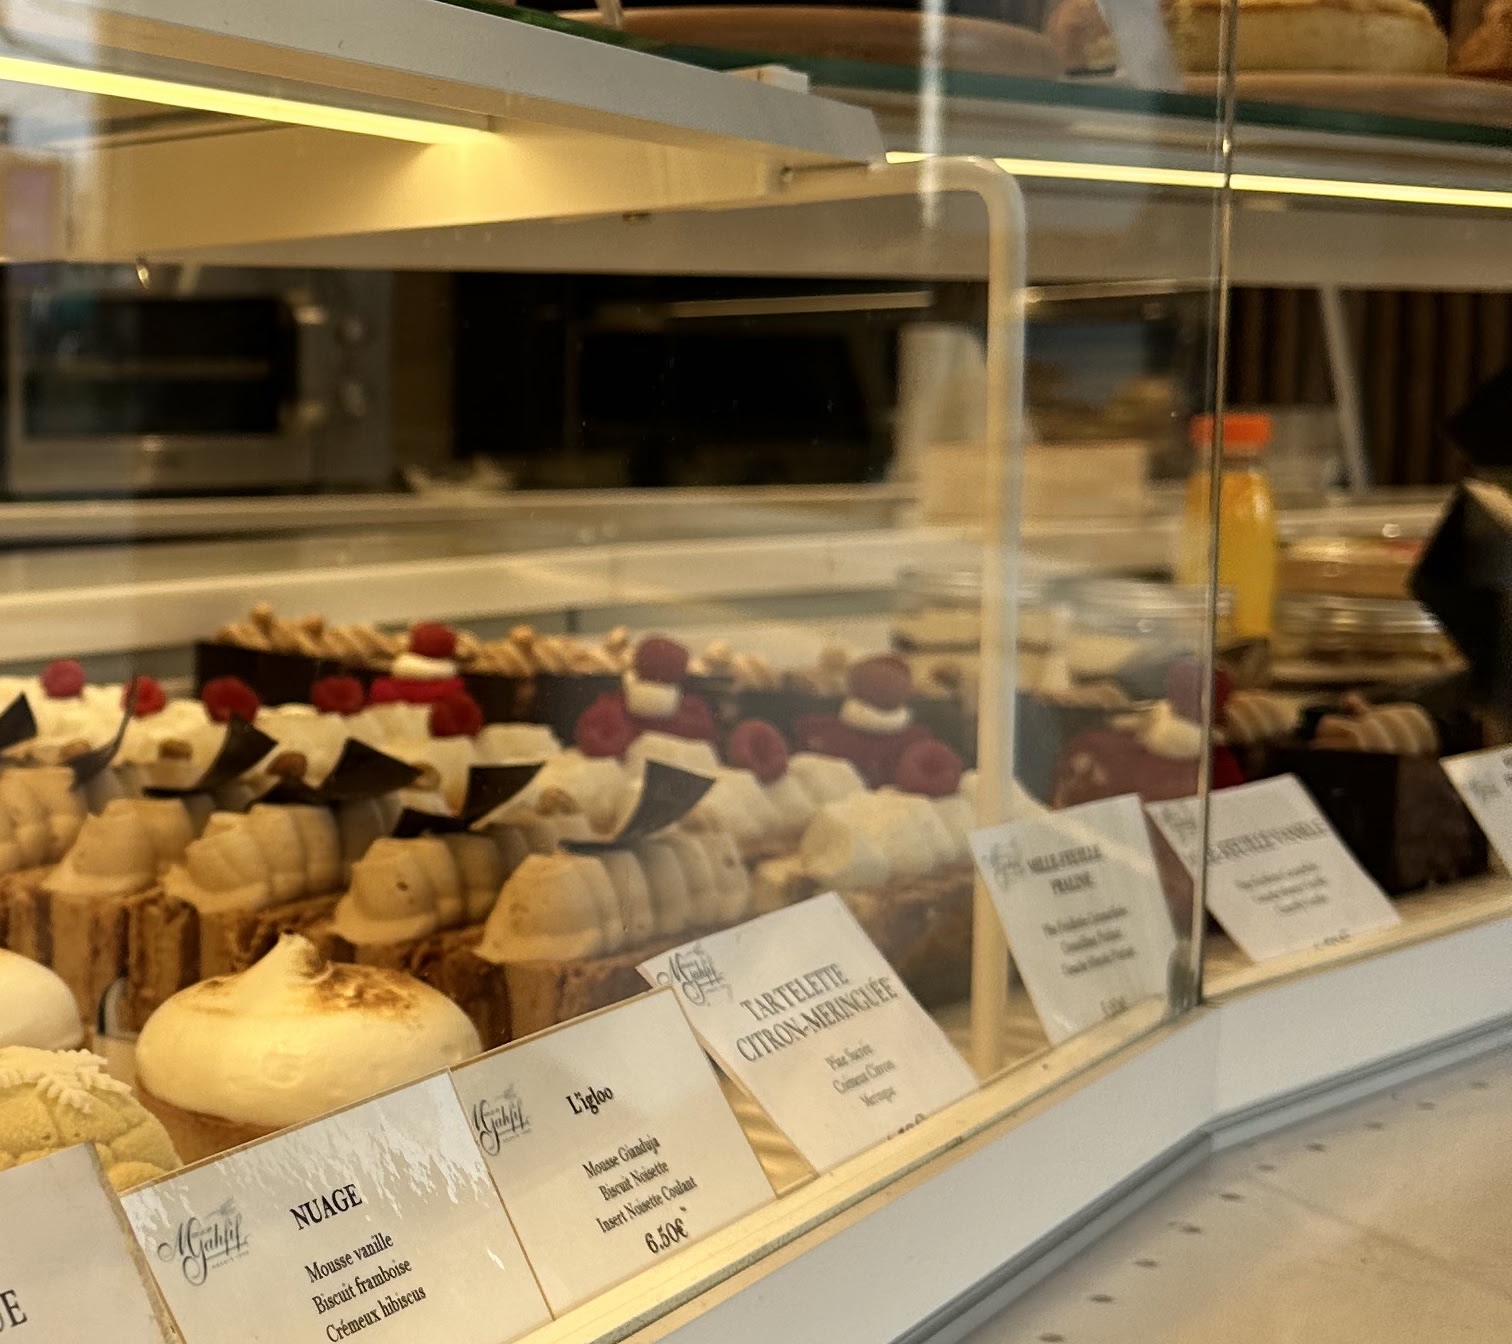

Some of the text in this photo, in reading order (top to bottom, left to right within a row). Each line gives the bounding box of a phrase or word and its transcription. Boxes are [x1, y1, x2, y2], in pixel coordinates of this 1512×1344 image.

[740, 963, 850, 1022] TARTELETTE
[736, 976, 898, 1063] CITRON-MERINGUÉE
[582, 1134, 660, 1179] Mousse Gianduja
[598, 1159, 669, 1201] Biscuit Noisette
[290, 1184, 363, 1231] NUAGE
[595, 1176, 698, 1233] Insert Noisette Coulant
[304, 1232, 394, 1283] Mousse vanille
[644, 1218, 689, 1254] 6.50€
[312, 1258, 412, 1314] Biscuit framboise
[326, 1286, 427, 1343] Crémeux hibiscus
